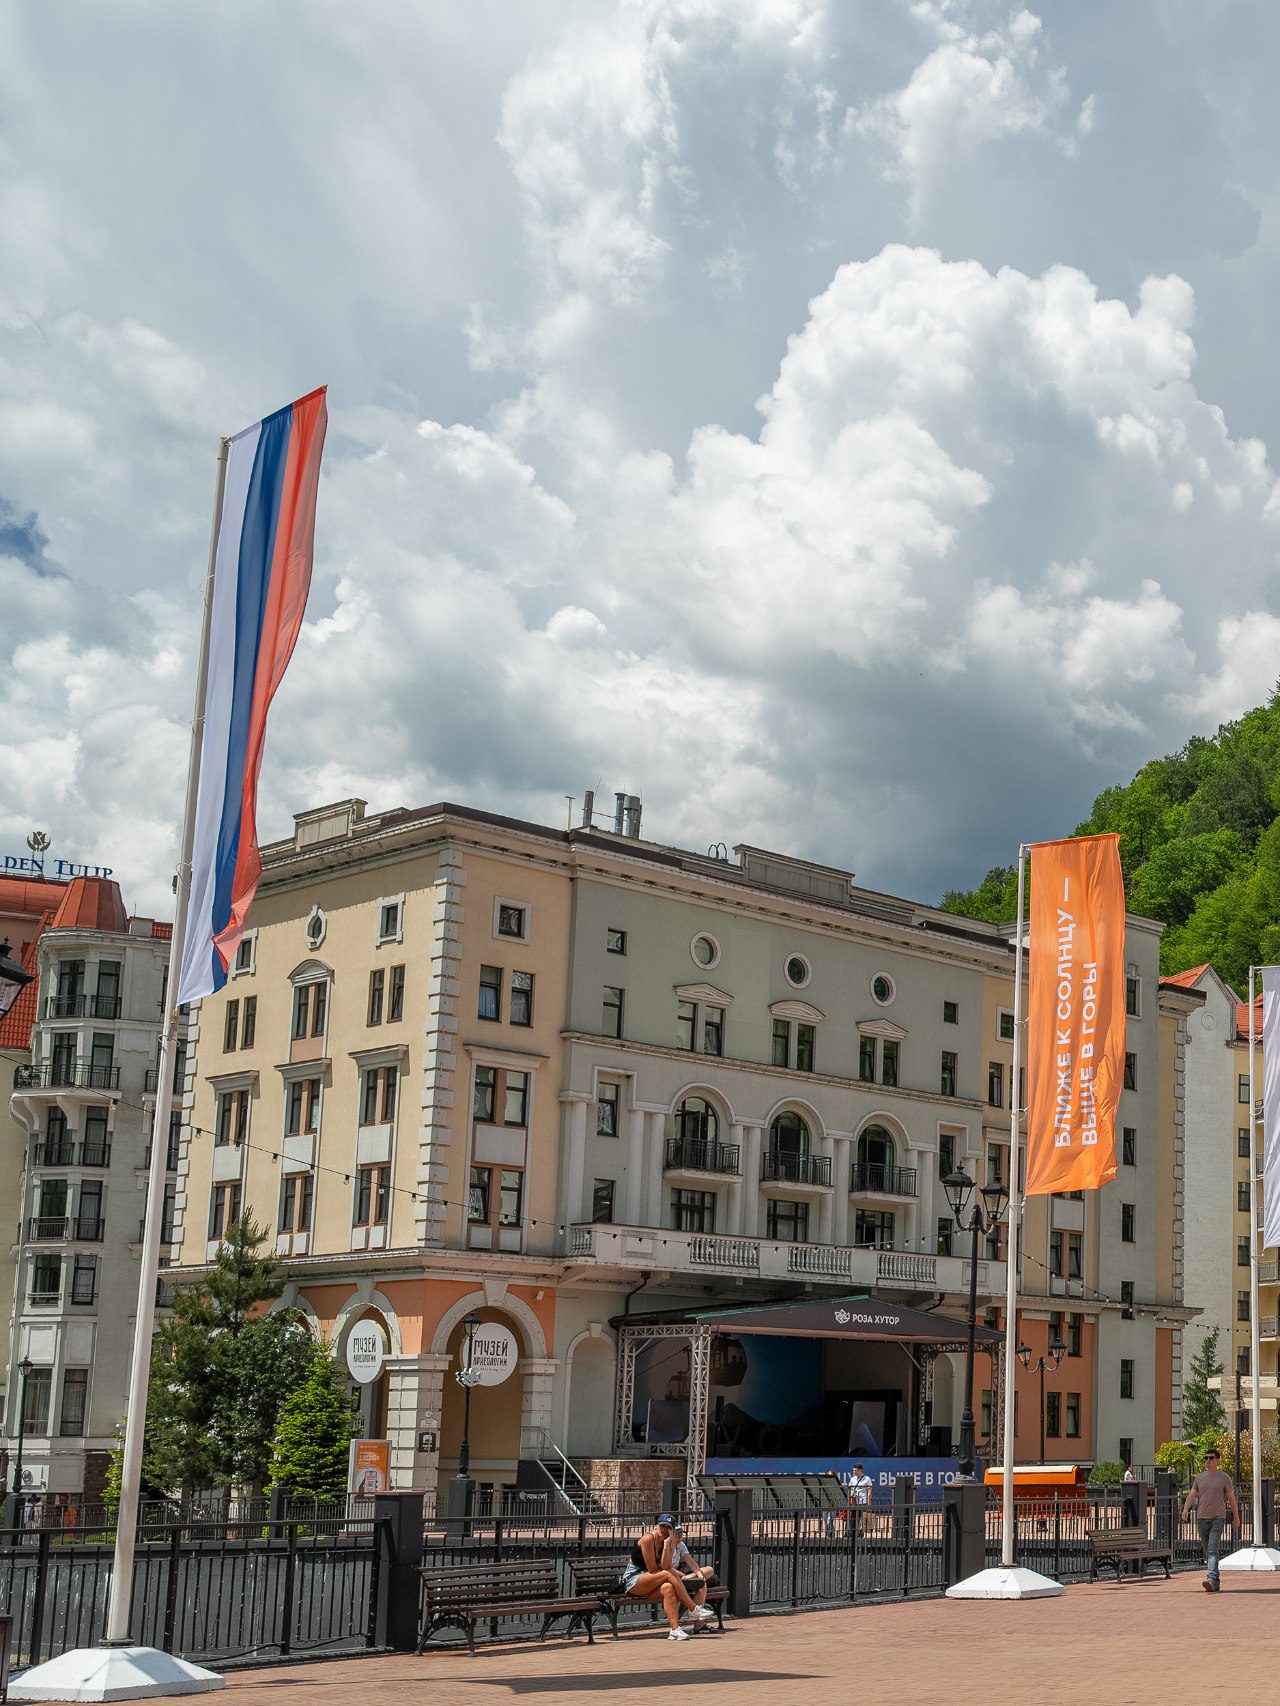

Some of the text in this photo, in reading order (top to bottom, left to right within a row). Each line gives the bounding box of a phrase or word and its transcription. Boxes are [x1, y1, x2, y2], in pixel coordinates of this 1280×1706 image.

[1057, 909, 1076, 1020] СОЛНЦУ
[1057, 1028, 1071, 1044] К
[1080, 962, 1098, 1145] ВЫШЕ В ГОРЫ
[1054, 1053, 1072, 1147] БЛИЖЕ
[852, 1313, 900, 1325] РОЗА ХУТОР
[353, 1334, 377, 1353] МУЗЕЙ
[474, 1338, 508, 1357] МУЗЕЙ
[925, 1471, 934, 1486] В
